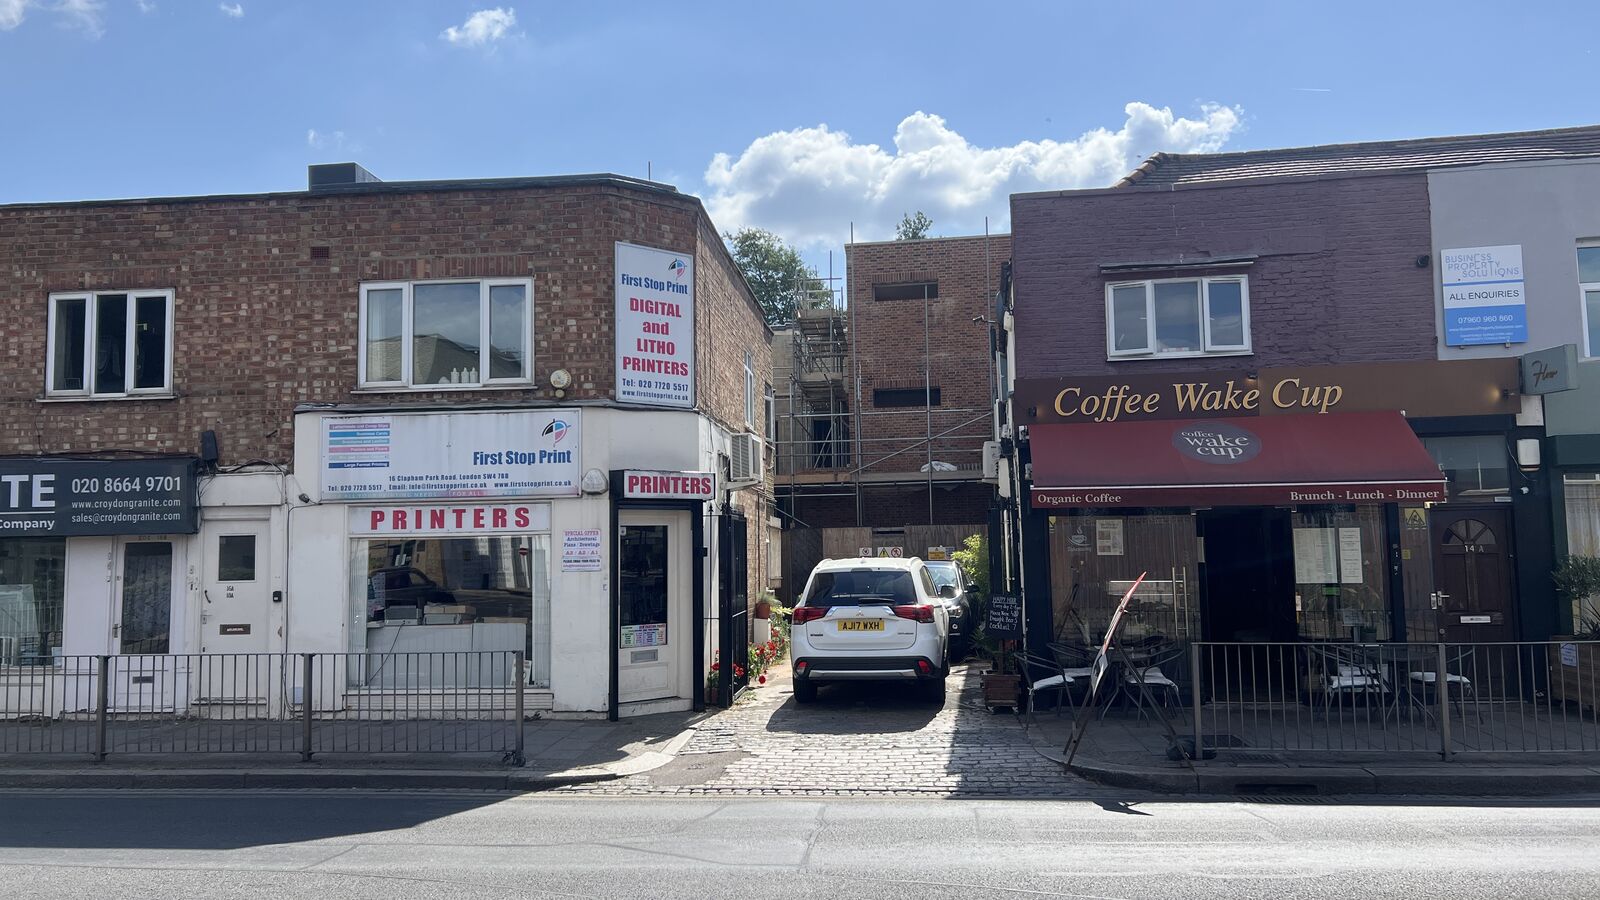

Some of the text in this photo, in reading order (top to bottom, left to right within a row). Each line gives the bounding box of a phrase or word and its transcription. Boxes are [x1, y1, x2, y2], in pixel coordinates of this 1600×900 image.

[1445, 253, 1492, 263] BUSINESS
[1448, 261, 1500, 271] PROPERTY
[1463, 267, 1519, 278] SOLUTIONS
[621, 273, 688, 295] First Stop Print
[1449, 290, 1520, 301] ALL ENQUIRIES
[629, 297, 682, 318] DIGITAL
[1483, 315, 1497, 323] 960
[643, 321, 669, 335] and
[637, 338, 675, 356] LITHO
[623, 356, 689, 377] PRINTERS
[622, 378, 689, 392] Tel: 020 7720 5517
[1054, 378, 1343, 422] Coffee Wake Cup
[1181, 430, 1214, 438] coffee
[1182, 433, 1250, 447] wake
[473, 450, 572, 466] First Stop Print
[1196, 446, 1243, 459] cup
[71, 476, 181, 493] 020 8664 9701
[494, 480, 572, 489] www.firststopprint.co.uk
[628, 475, 712, 495] PRINTERS
[1037, 493, 1122, 506] Organic Coffee
[1290, 490, 1335, 501] Brunch
[1346, 489, 1385, 500] Lunch
[1396, 489, 1440, 499] Dinner
[71, 498, 181, 510] www.croydongranite.com
[71, 512, 181, 524] sales@croydongranite.com
[371, 507, 530, 530] PRINTERS
[1465, 545, 1475, 553] 14
[842, 620, 880, 630] AJ17 WXH
